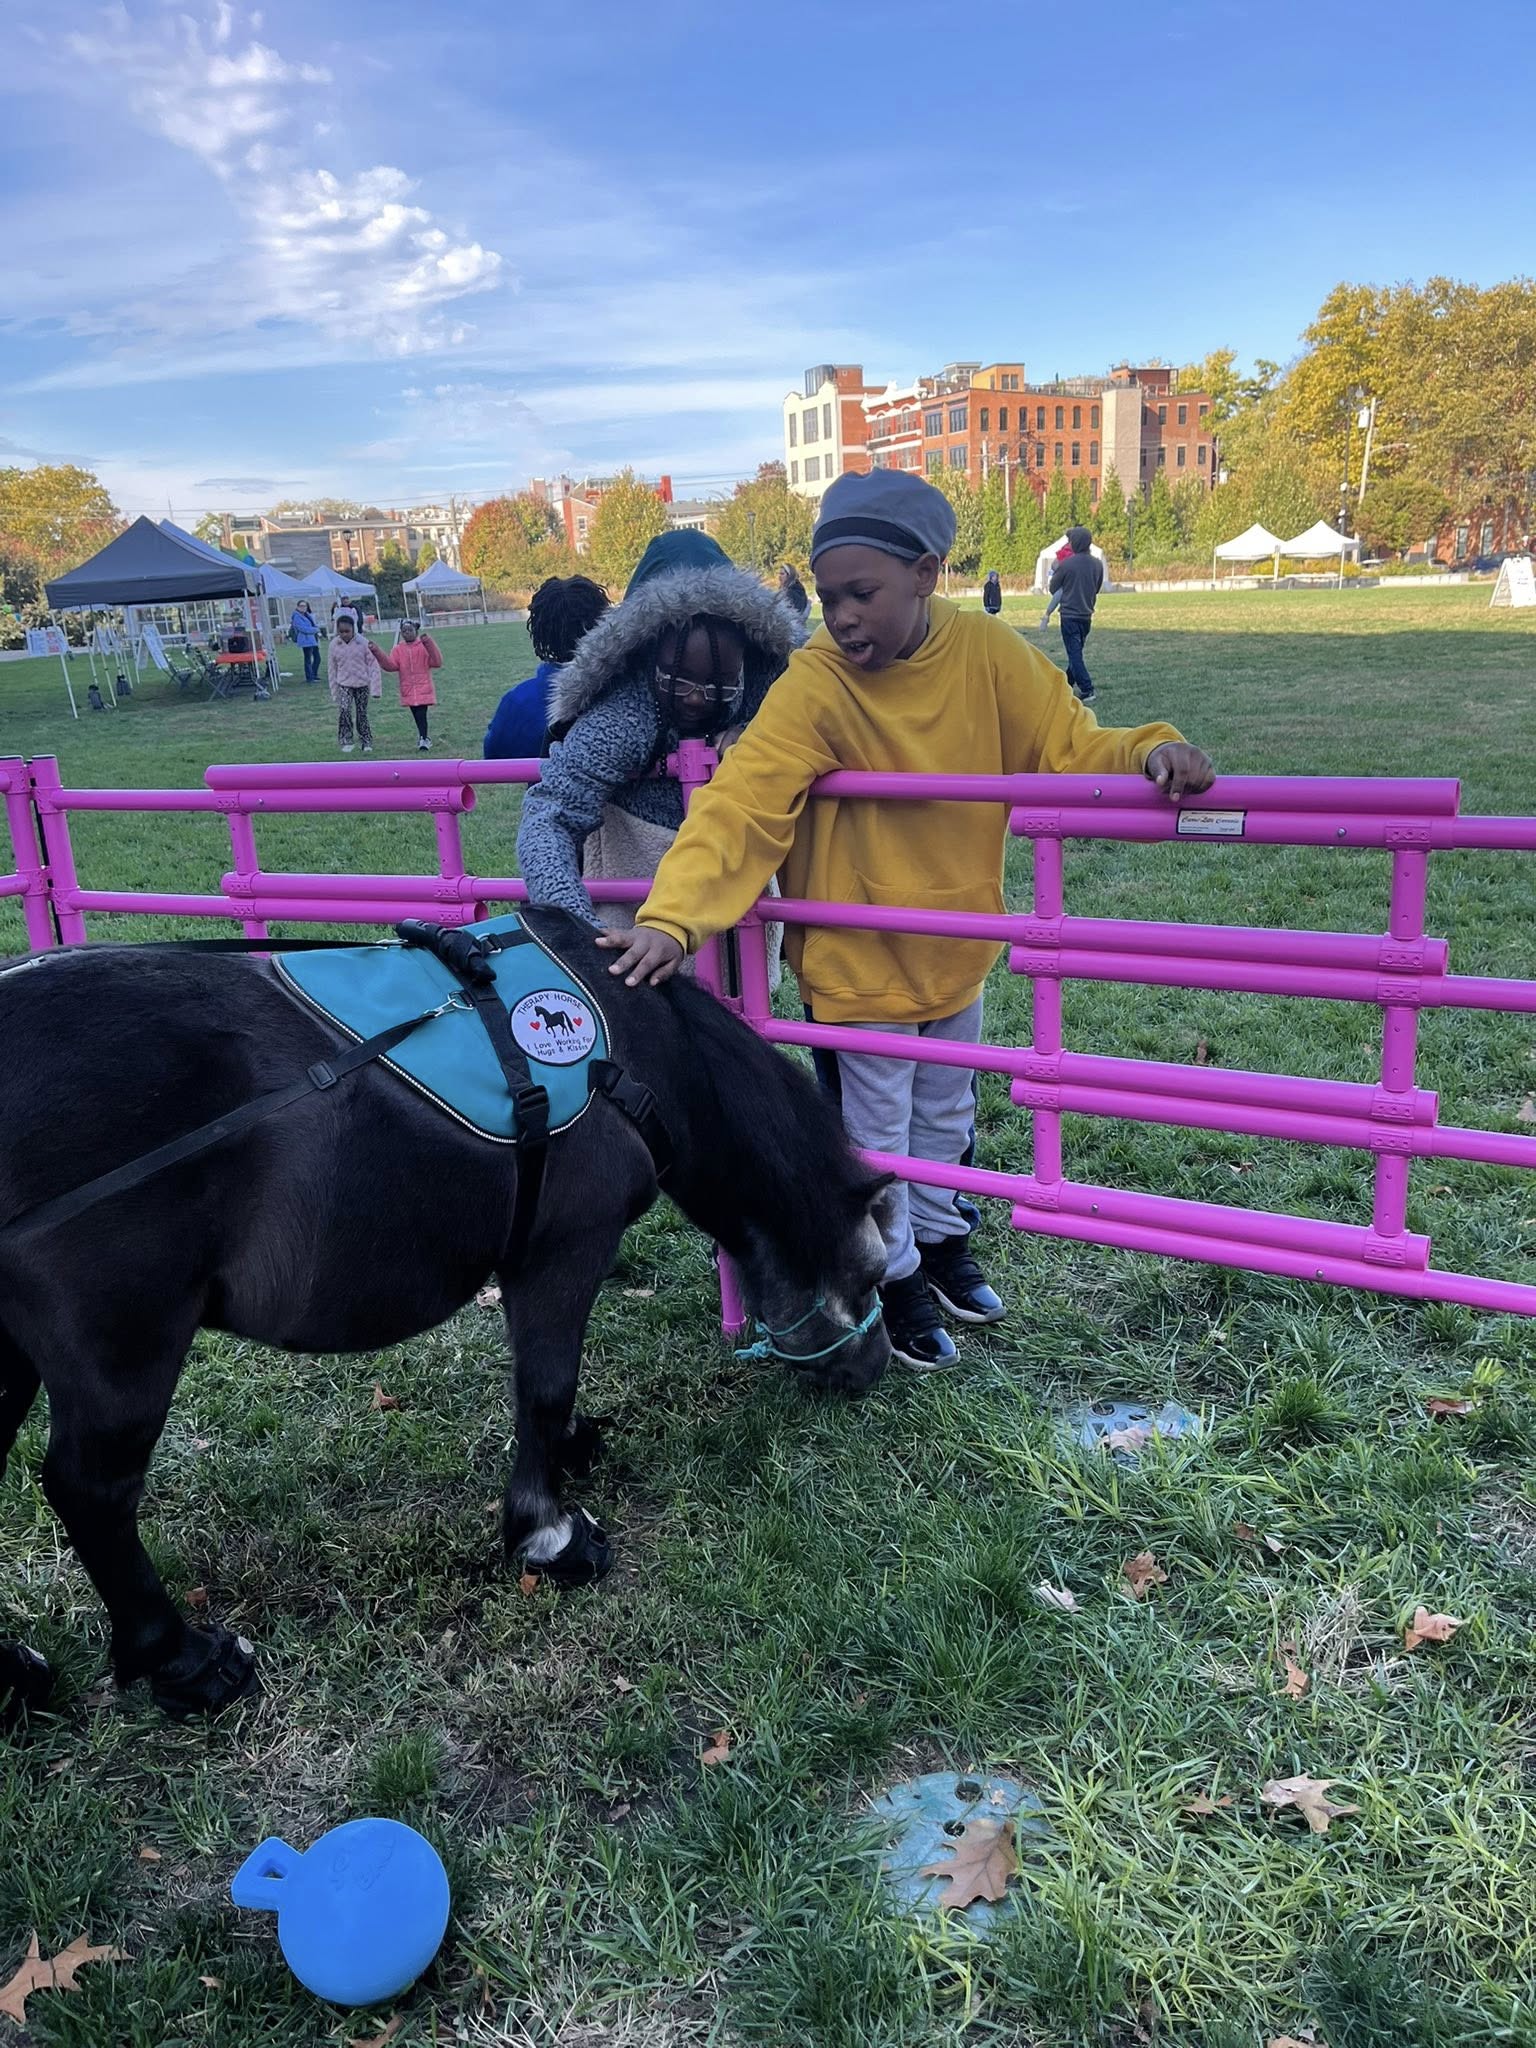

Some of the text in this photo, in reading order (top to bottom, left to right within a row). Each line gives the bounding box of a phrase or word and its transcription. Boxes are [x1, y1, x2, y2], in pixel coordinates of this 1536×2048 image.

[517, 993, 583, 1015] THERAPY HORSE
[537, 1048, 555, 1056] Hugs
